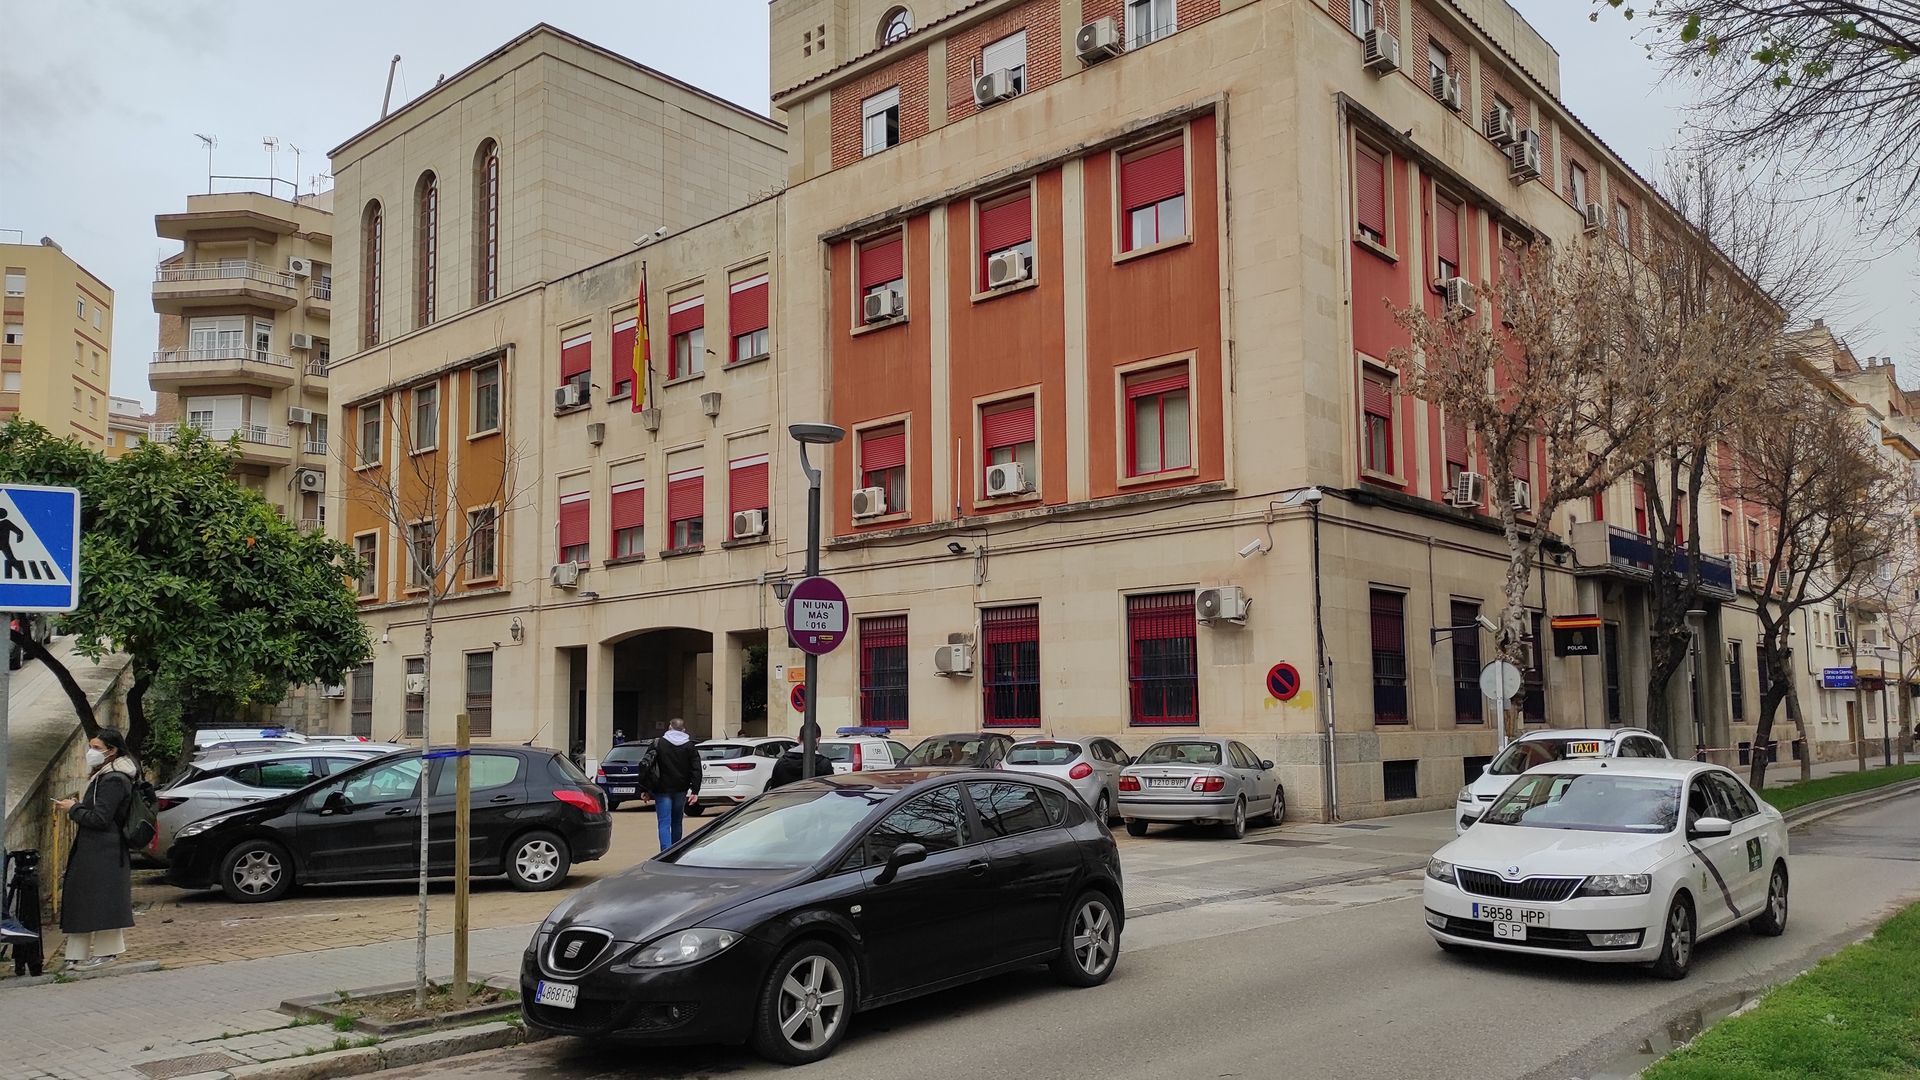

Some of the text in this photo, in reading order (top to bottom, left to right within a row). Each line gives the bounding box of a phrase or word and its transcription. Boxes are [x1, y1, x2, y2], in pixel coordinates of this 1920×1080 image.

[802, 601, 834, 610] NI UNA
[808, 610, 829, 619] MÁS
[810, 621, 827, 629] 016
[1574, 743, 1592, 753] TAXI
[1482, 905, 1545, 924] 5858 HPP
[1498, 923, 1521, 937] SP
[542, 986, 561, 1001] 4868
